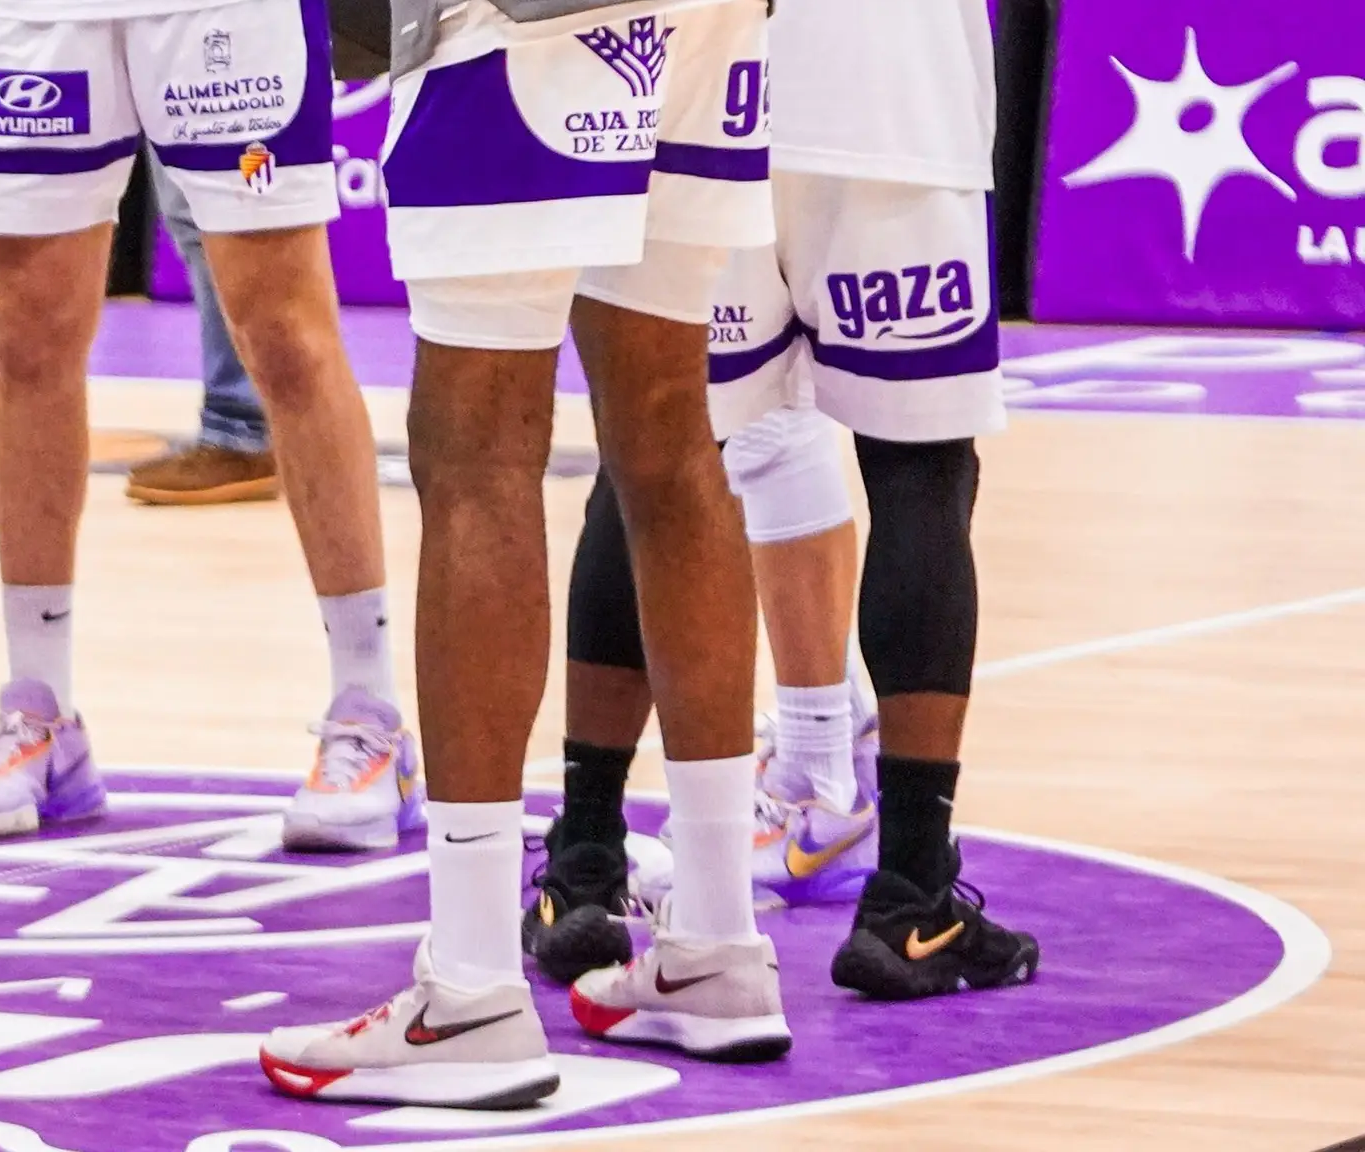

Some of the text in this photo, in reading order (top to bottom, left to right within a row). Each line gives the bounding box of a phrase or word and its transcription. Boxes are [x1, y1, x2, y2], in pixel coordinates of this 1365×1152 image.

[164, 76, 283, 101] ALIMENTOS
[166, 95, 285, 117] DE VALLADOLID
[565, 110, 628, 132] CAJA
[573, 135, 605, 154] DE
[826, 260, 973, 339] gaza
